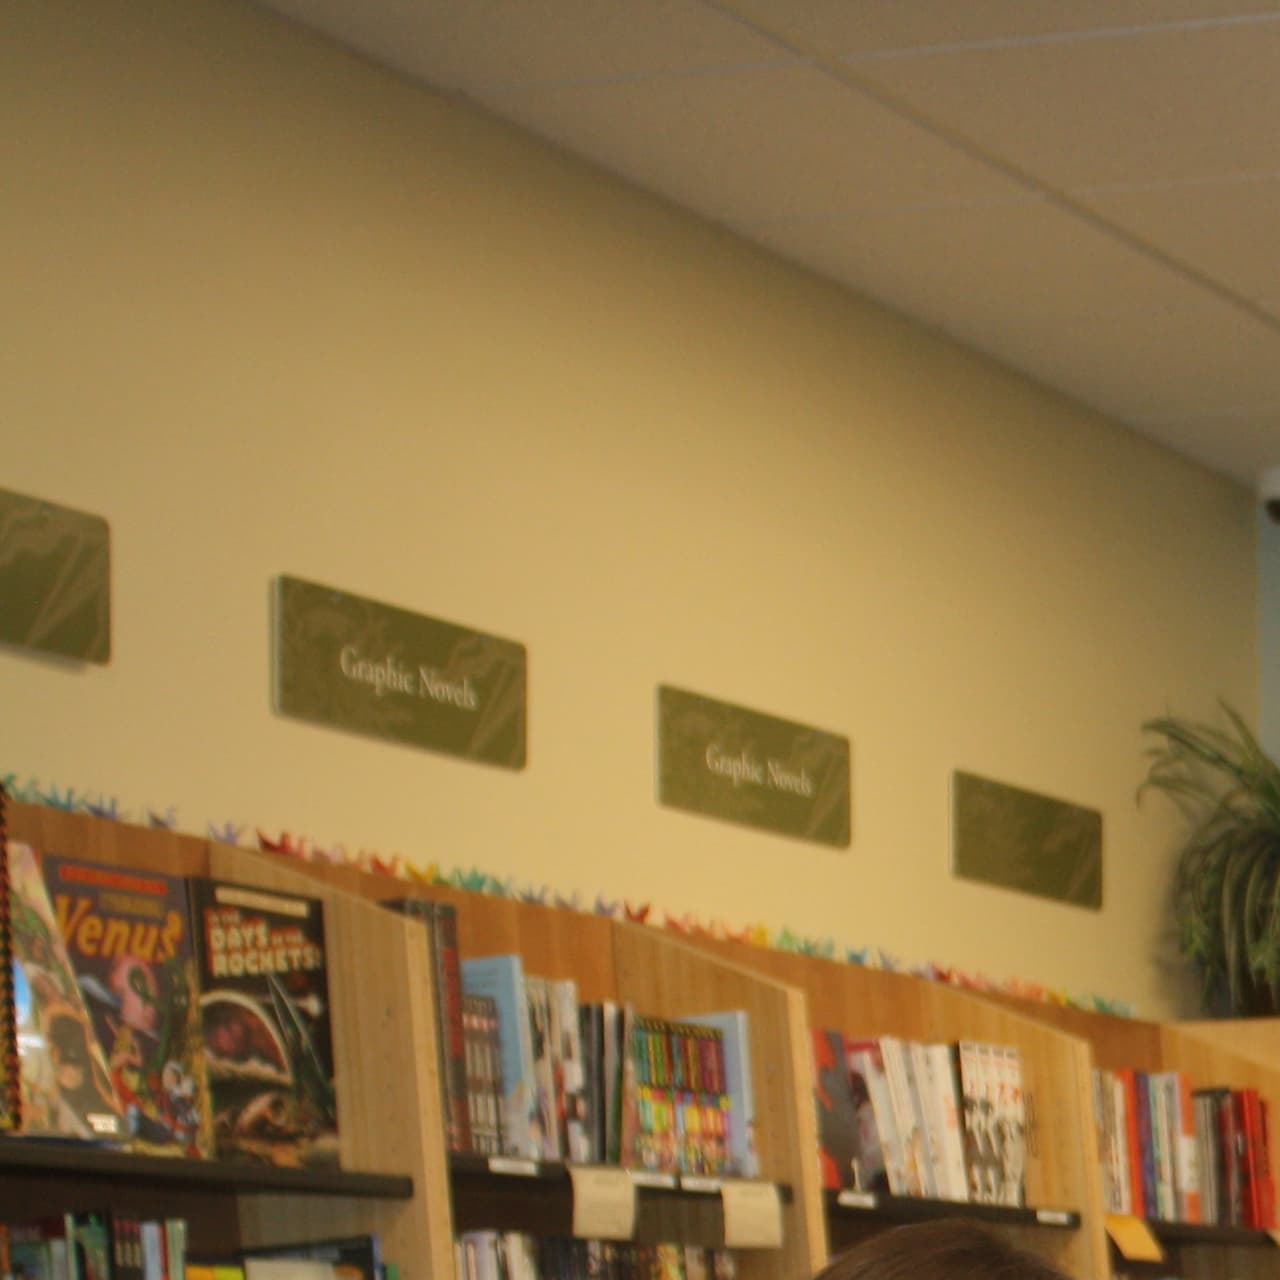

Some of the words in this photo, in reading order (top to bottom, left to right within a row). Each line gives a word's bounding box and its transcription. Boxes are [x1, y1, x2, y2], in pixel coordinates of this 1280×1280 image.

[340, 647, 413, 697] Graphic
[419, 665, 477, 711] Novels
[705, 743, 763, 787] Graphic
[767, 759, 813, 797] Novels
[54, 893, 184, 963] Venus
[209, 921, 268, 952] DAYS
